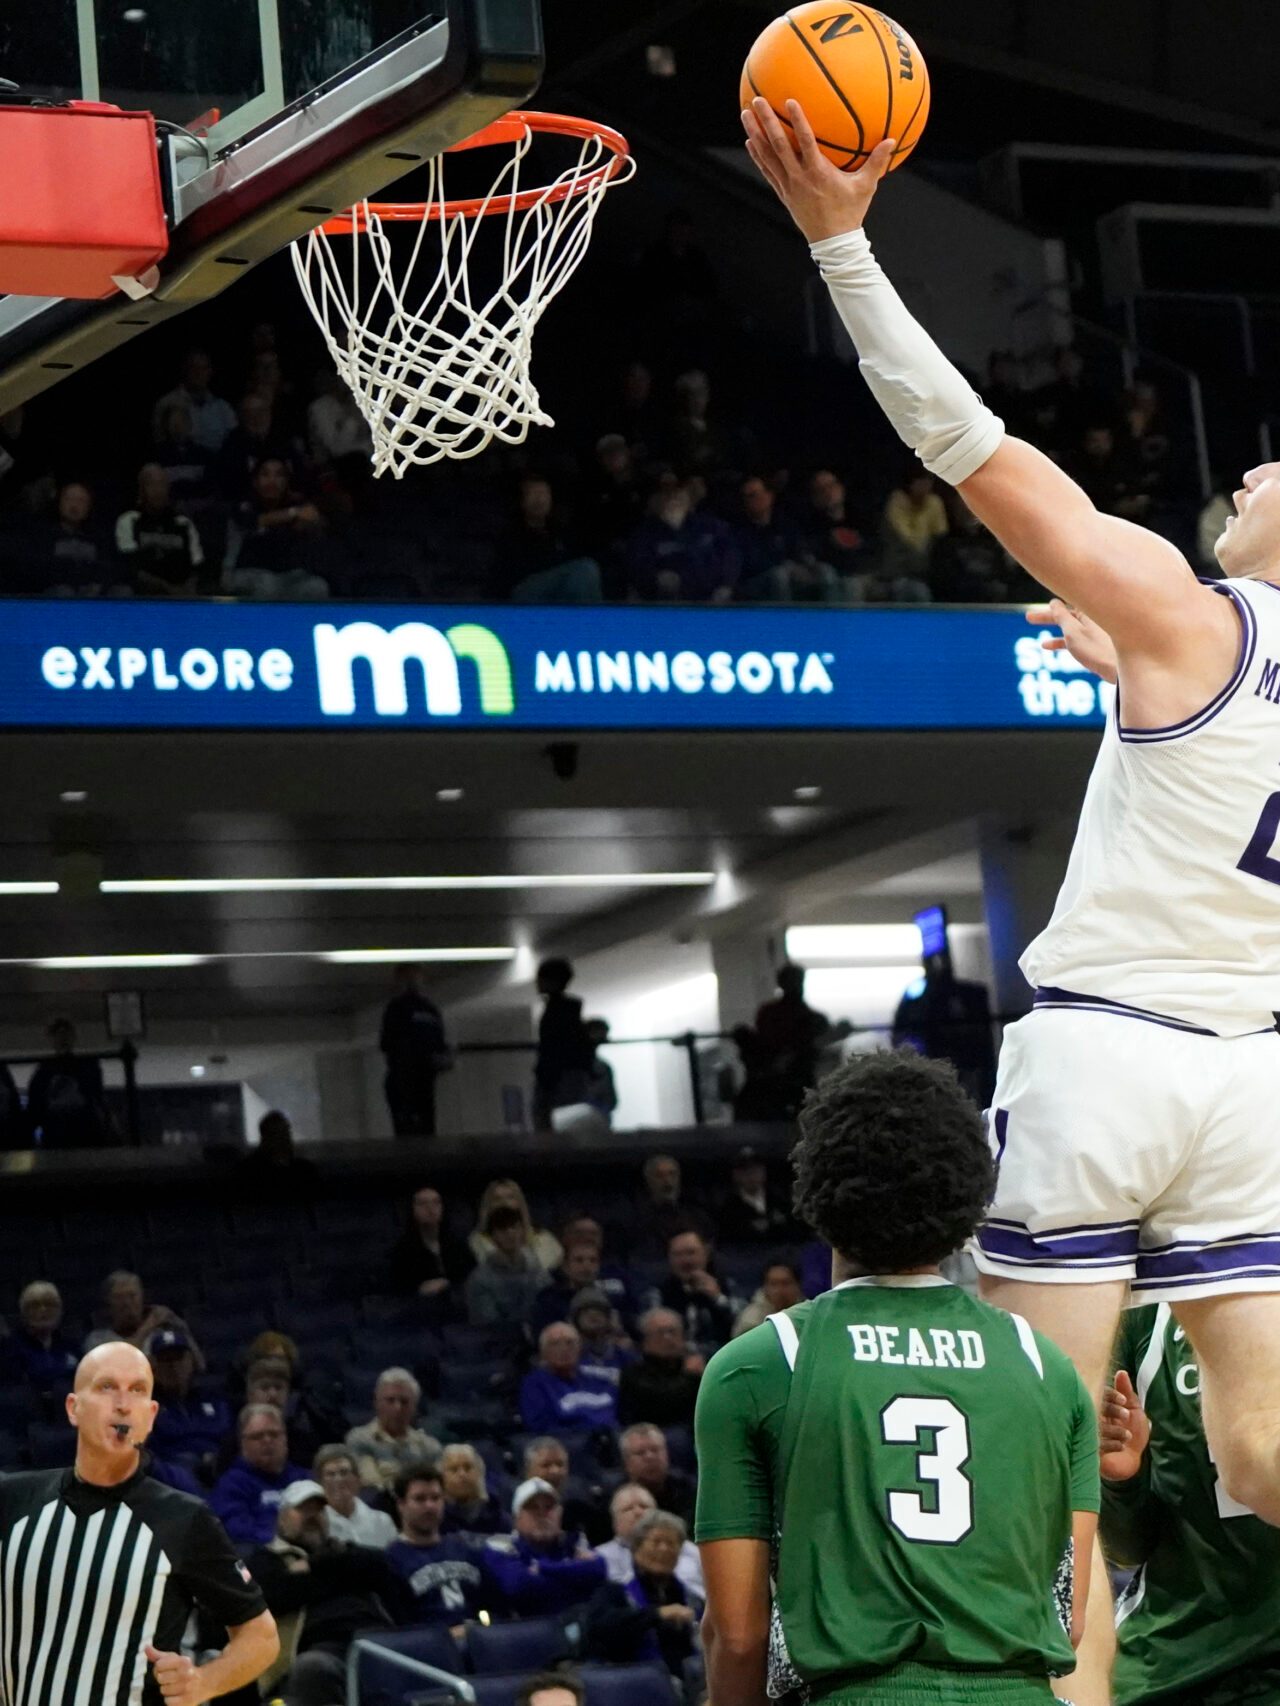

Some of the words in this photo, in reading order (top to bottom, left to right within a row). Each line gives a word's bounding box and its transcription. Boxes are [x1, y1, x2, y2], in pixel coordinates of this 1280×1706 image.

[1017, 668, 1095, 716] the
[847, 1324, 986, 1369] BEARD
[879, 1393, 975, 1547] 3
